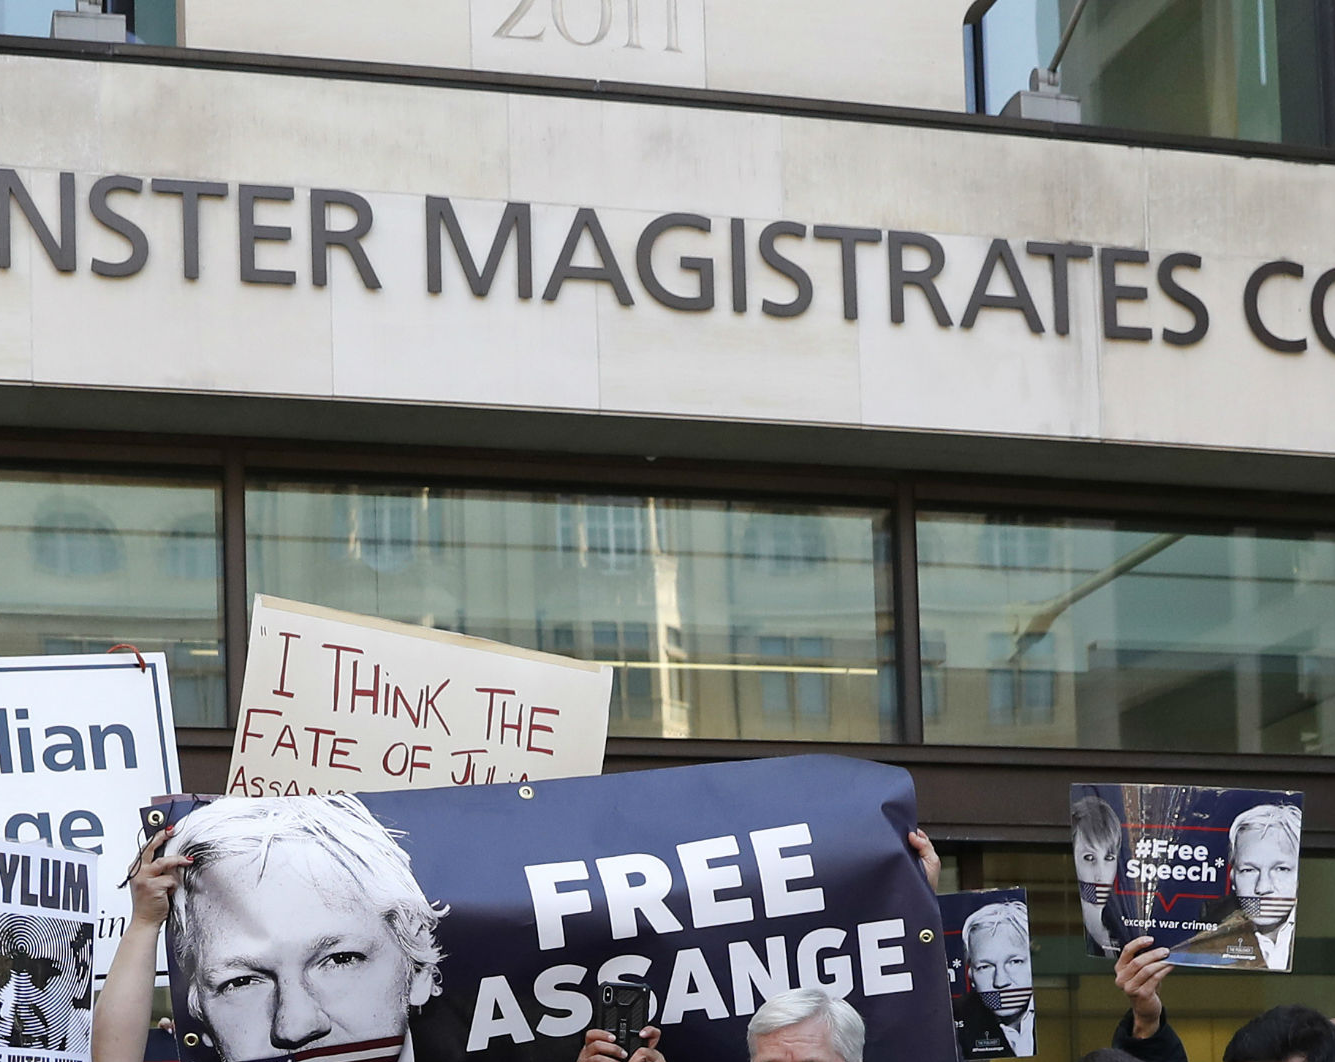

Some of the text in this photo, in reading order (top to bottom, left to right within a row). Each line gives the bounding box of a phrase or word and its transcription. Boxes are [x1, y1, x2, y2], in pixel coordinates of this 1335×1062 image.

[424, 196, 1211, 347] MAGISTRATES
[241, 708, 362, 773] FATE
[382, 742, 433, 783] OF
[475, 688, 560, 756] THE
[1135, 839, 1208, 861] #Free
[523, 822, 826, 951] FREE
[1159, 921, 1179, 929] war
[1181, 920, 1218, 931] crimes
